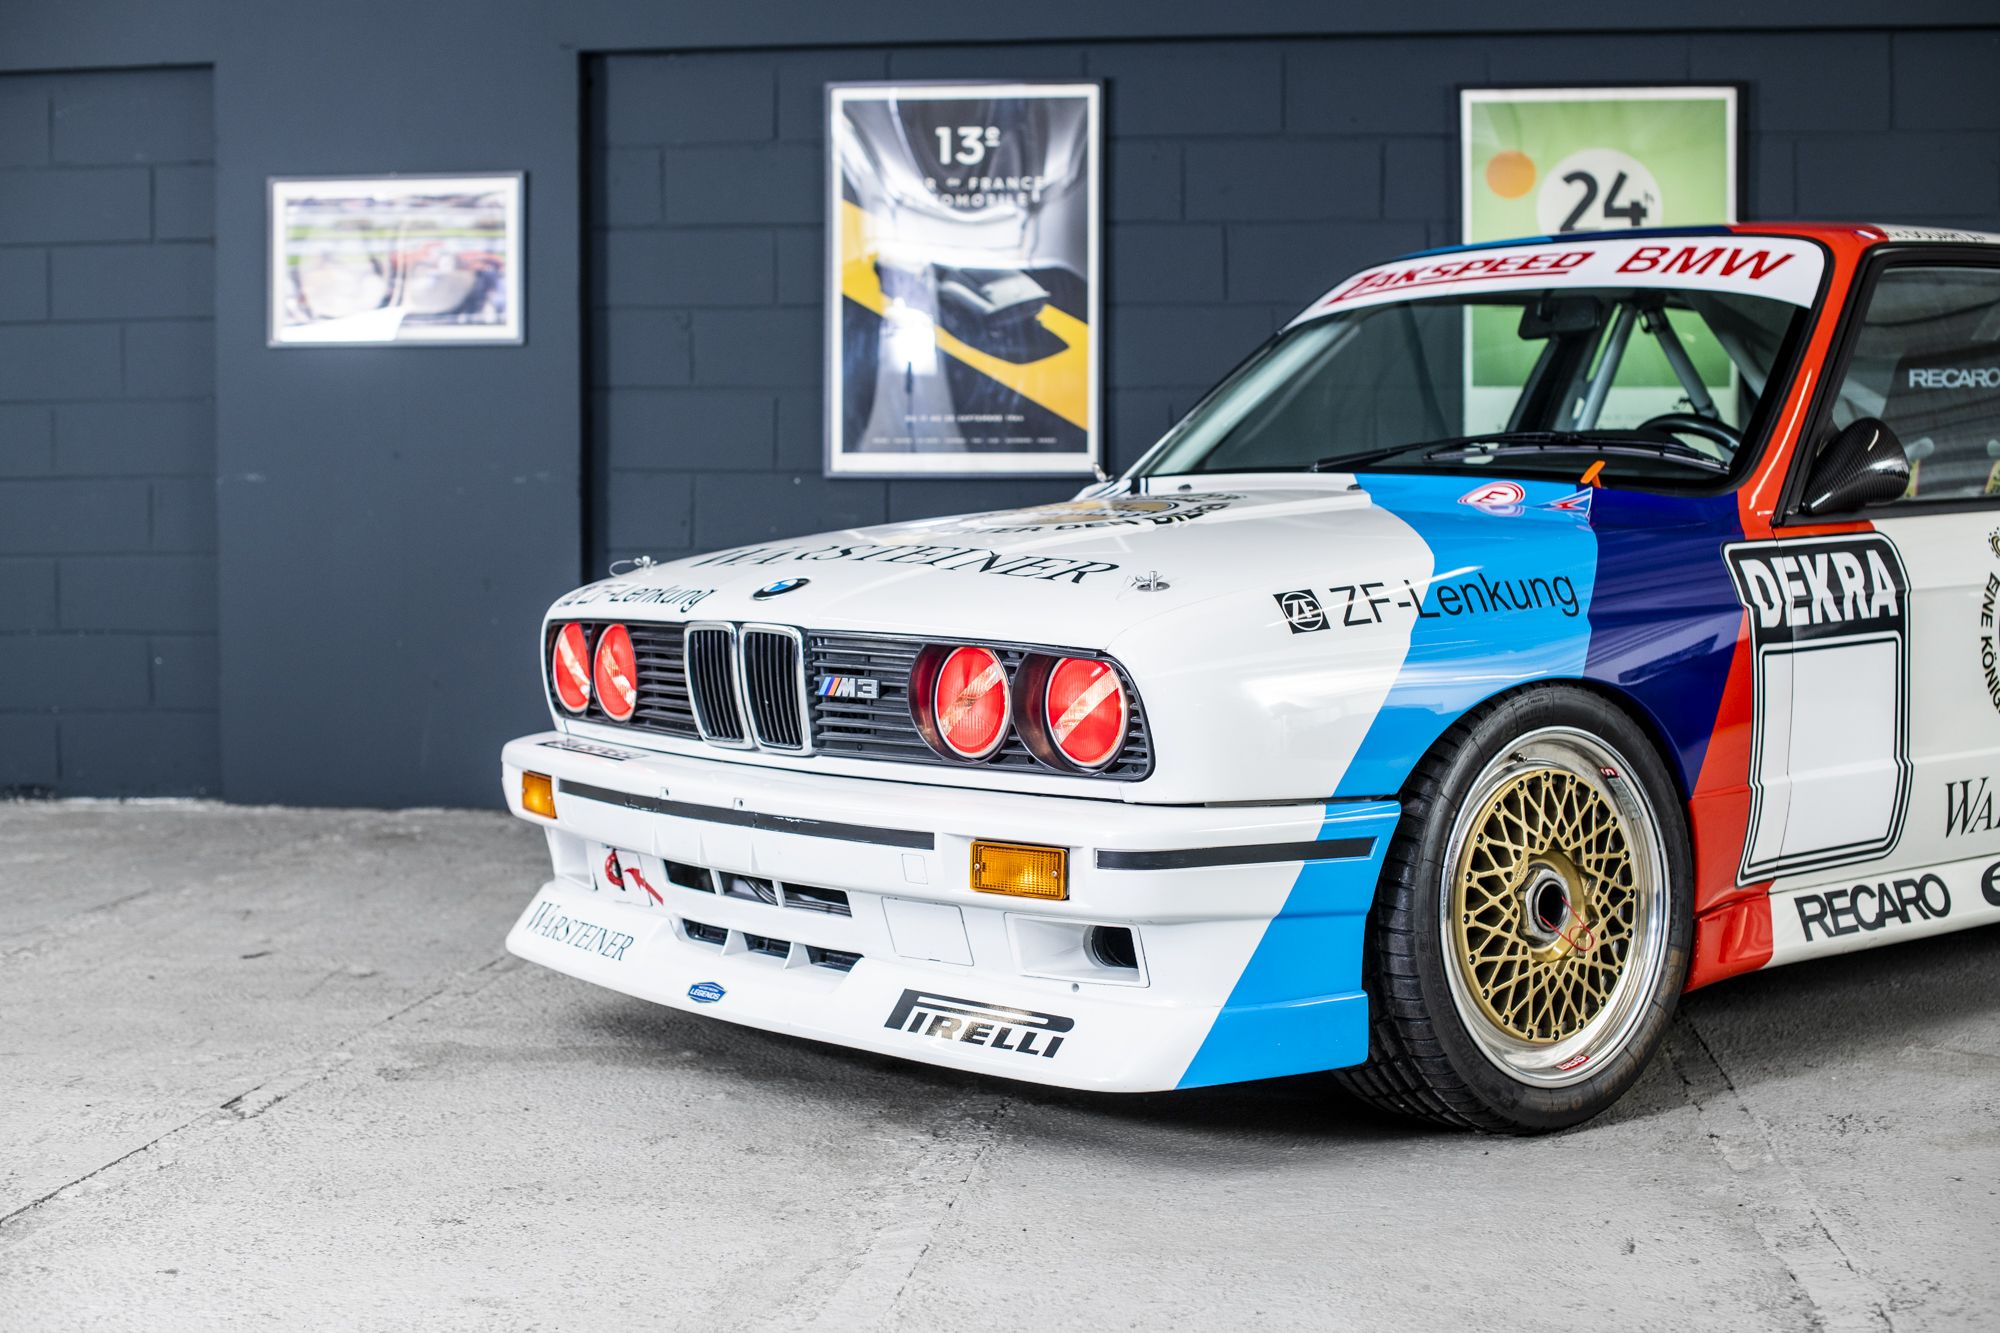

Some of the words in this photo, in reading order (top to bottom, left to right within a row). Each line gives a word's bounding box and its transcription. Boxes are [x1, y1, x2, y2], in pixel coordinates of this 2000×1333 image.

[1616, 247, 1796, 280] BMW
[1908, 367, 2000, 388] RECARO
[692, 544, 1121, 585] WARSTEINER
[1738, 549, 1899, 629] DEKRA
[1329, 573, 1580, 628] ZF-Lenkung
[1980, 571, 2000, 628] EINE
[1980, 636, 2000, 713] KÖNIG
[1945, 776, 2000, 839] WA
[526, 901, 634, 961] WARSTEINER
[1794, 873, 1952, 942] RECARO
[884, 988, 1075, 1059] PIRELLI
